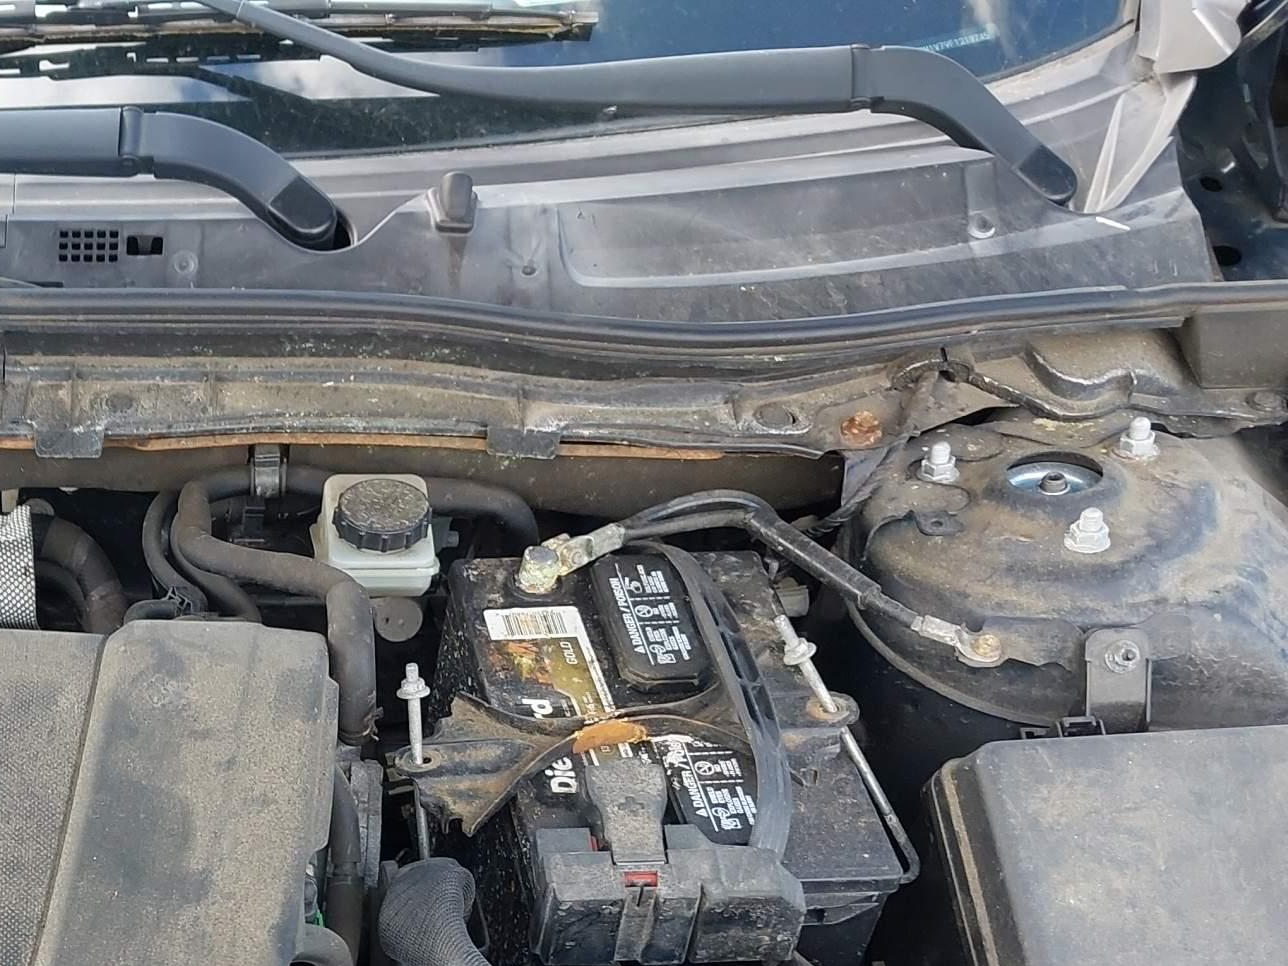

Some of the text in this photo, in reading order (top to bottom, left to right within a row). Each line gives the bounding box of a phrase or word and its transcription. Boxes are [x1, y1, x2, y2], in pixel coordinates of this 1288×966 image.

[609, 578, 627, 606] POISON
[622, 613, 643, 646] DANGER
[560, 641, 578, 665] GOLD
[681, 770, 705, 808] DANGER
